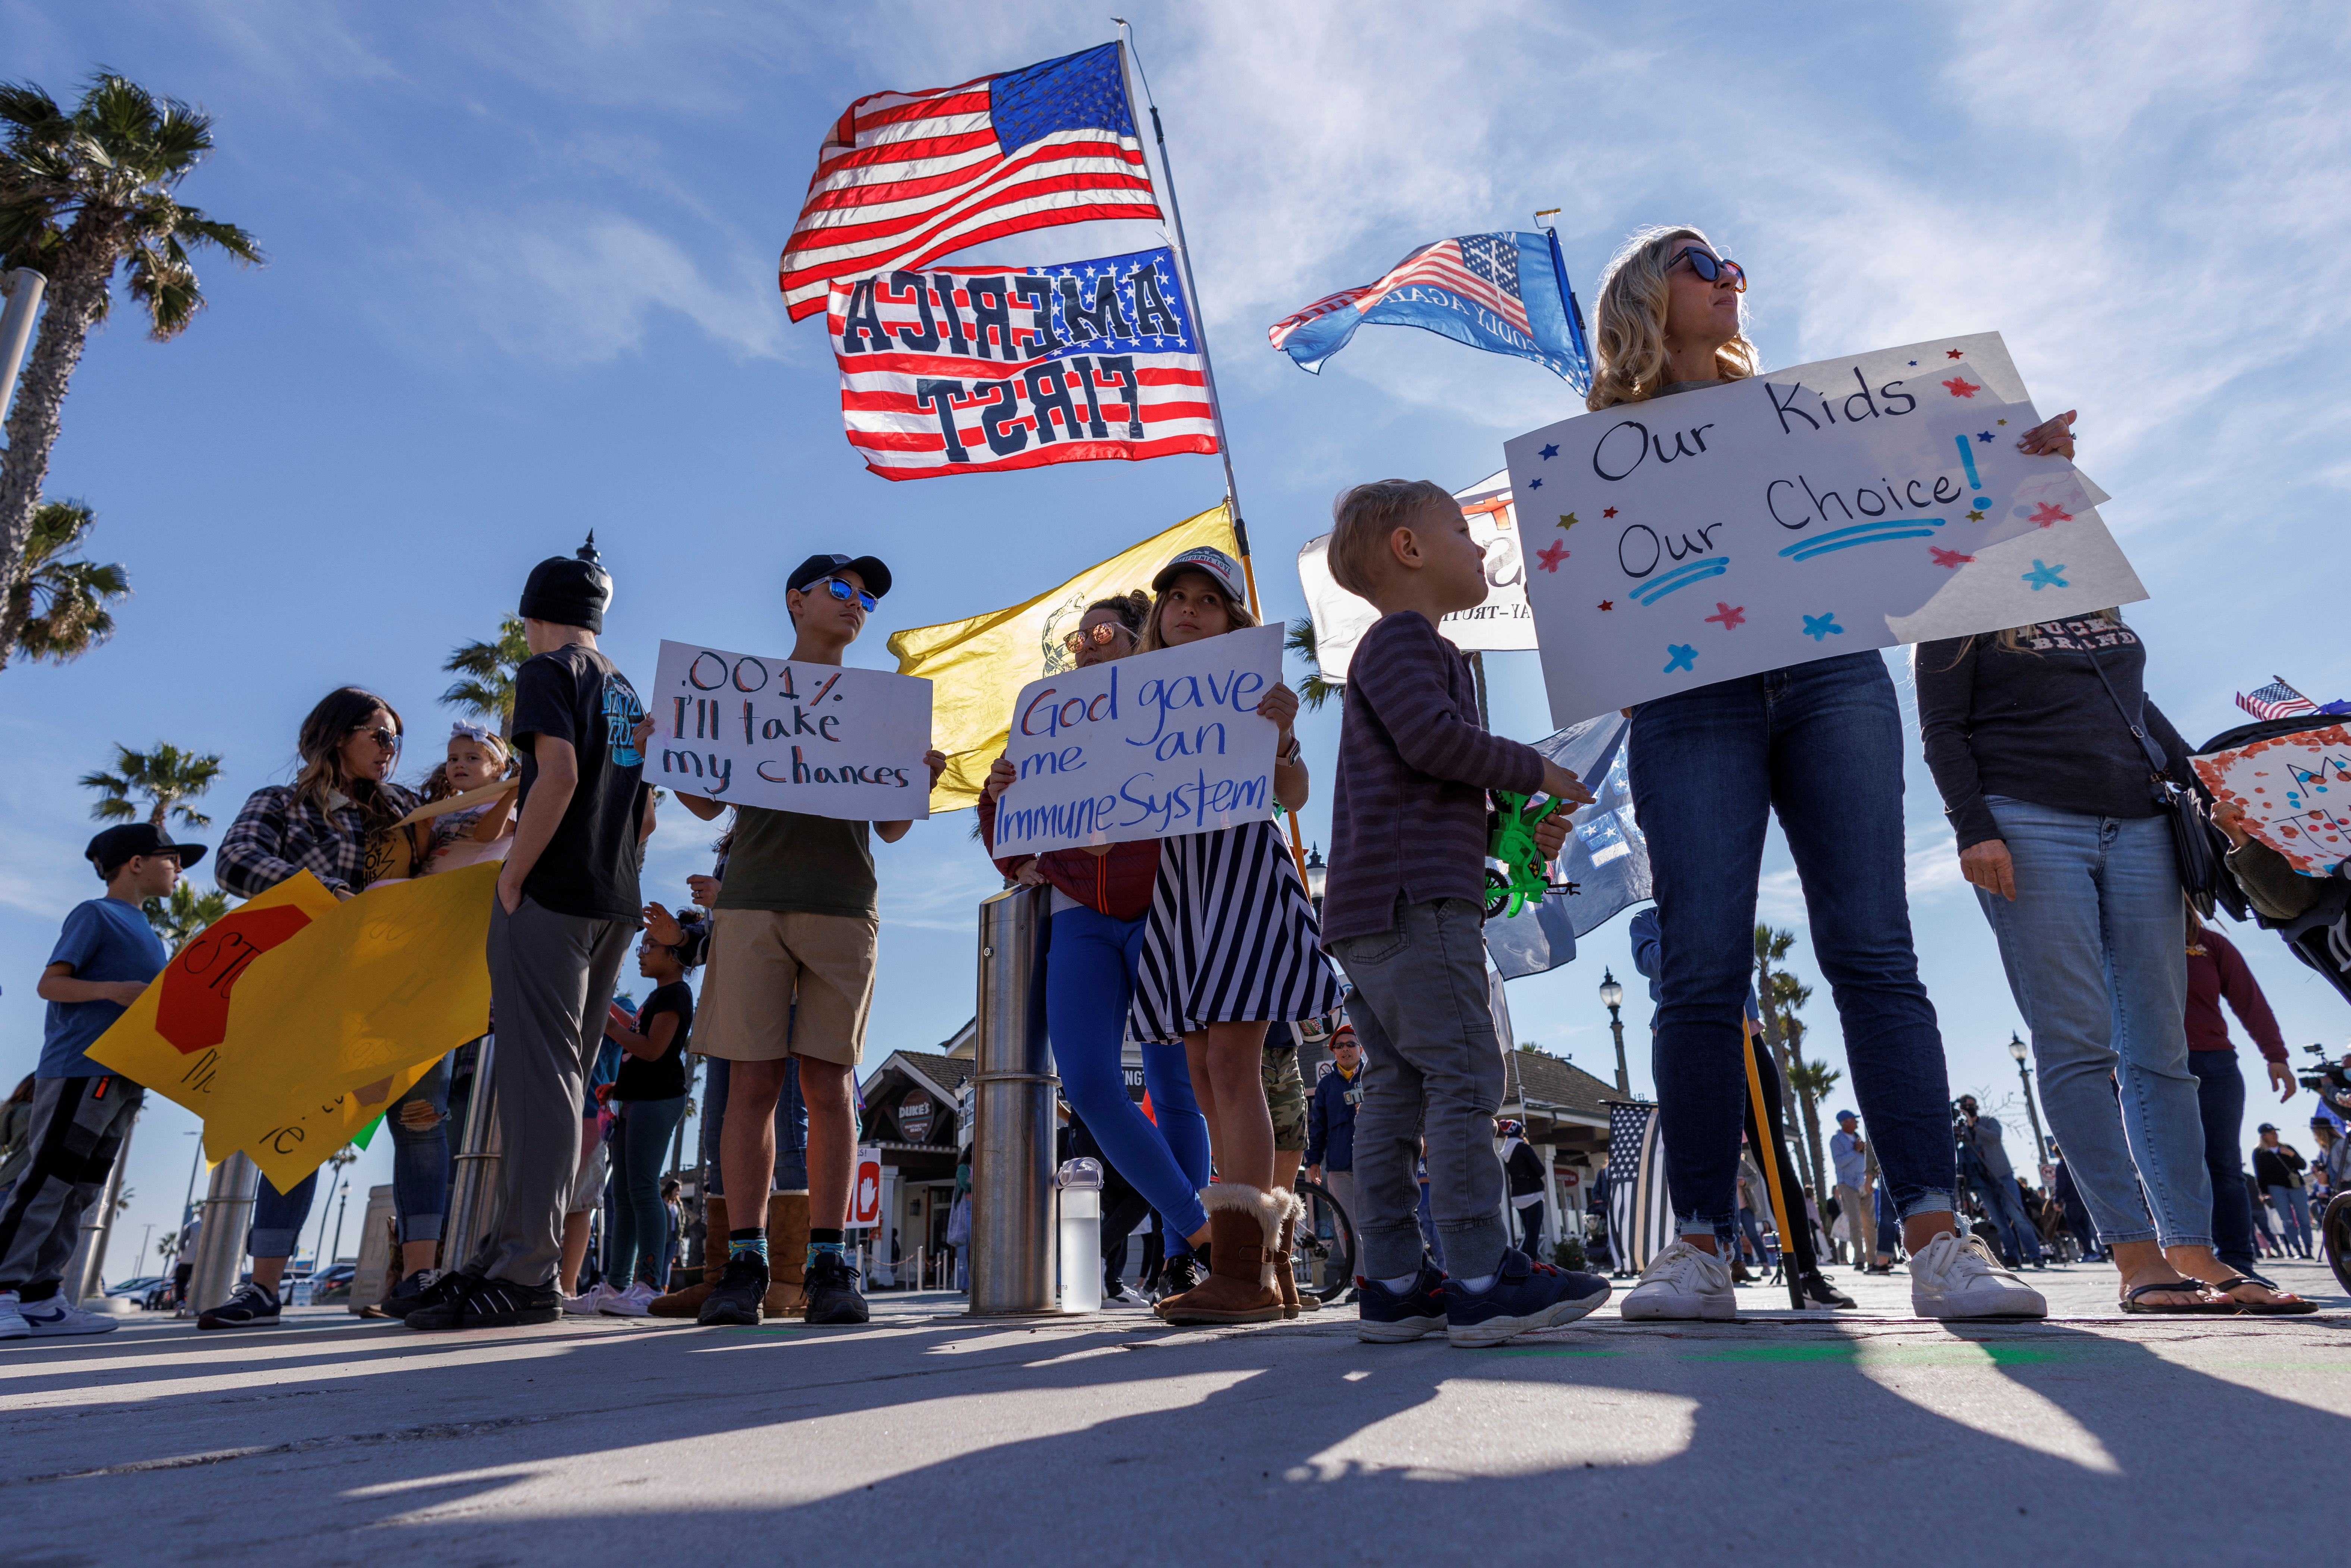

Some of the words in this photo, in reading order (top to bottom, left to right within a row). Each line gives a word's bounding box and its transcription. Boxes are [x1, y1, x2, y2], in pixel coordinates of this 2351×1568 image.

[1593, 420, 1715, 481] Our
[1764, 367, 1916, 434] Kids
[1618, 522, 1723, 578] Our
[1766, 434, 1993, 530] Choice!
[1215, 560, 1231, 573] LOVE
[2016, 618, 2129, 638] LUCK
[2030, 632, 2137, 650] BRAND
[681, 651, 843, 706] .001%
[672, 694, 719, 740] I'll
[738, 698, 841, 747] take
[1020, 666, 1118, 738] God
[1126, 670, 1264, 746] gave
[663, 749, 731, 795] my
[757, 746, 910, 788] chances
[1021, 747, 1087, 780] me
[1156, 723, 1225, 761] an
[899, 1102, 931, 1118] DUKE'S
